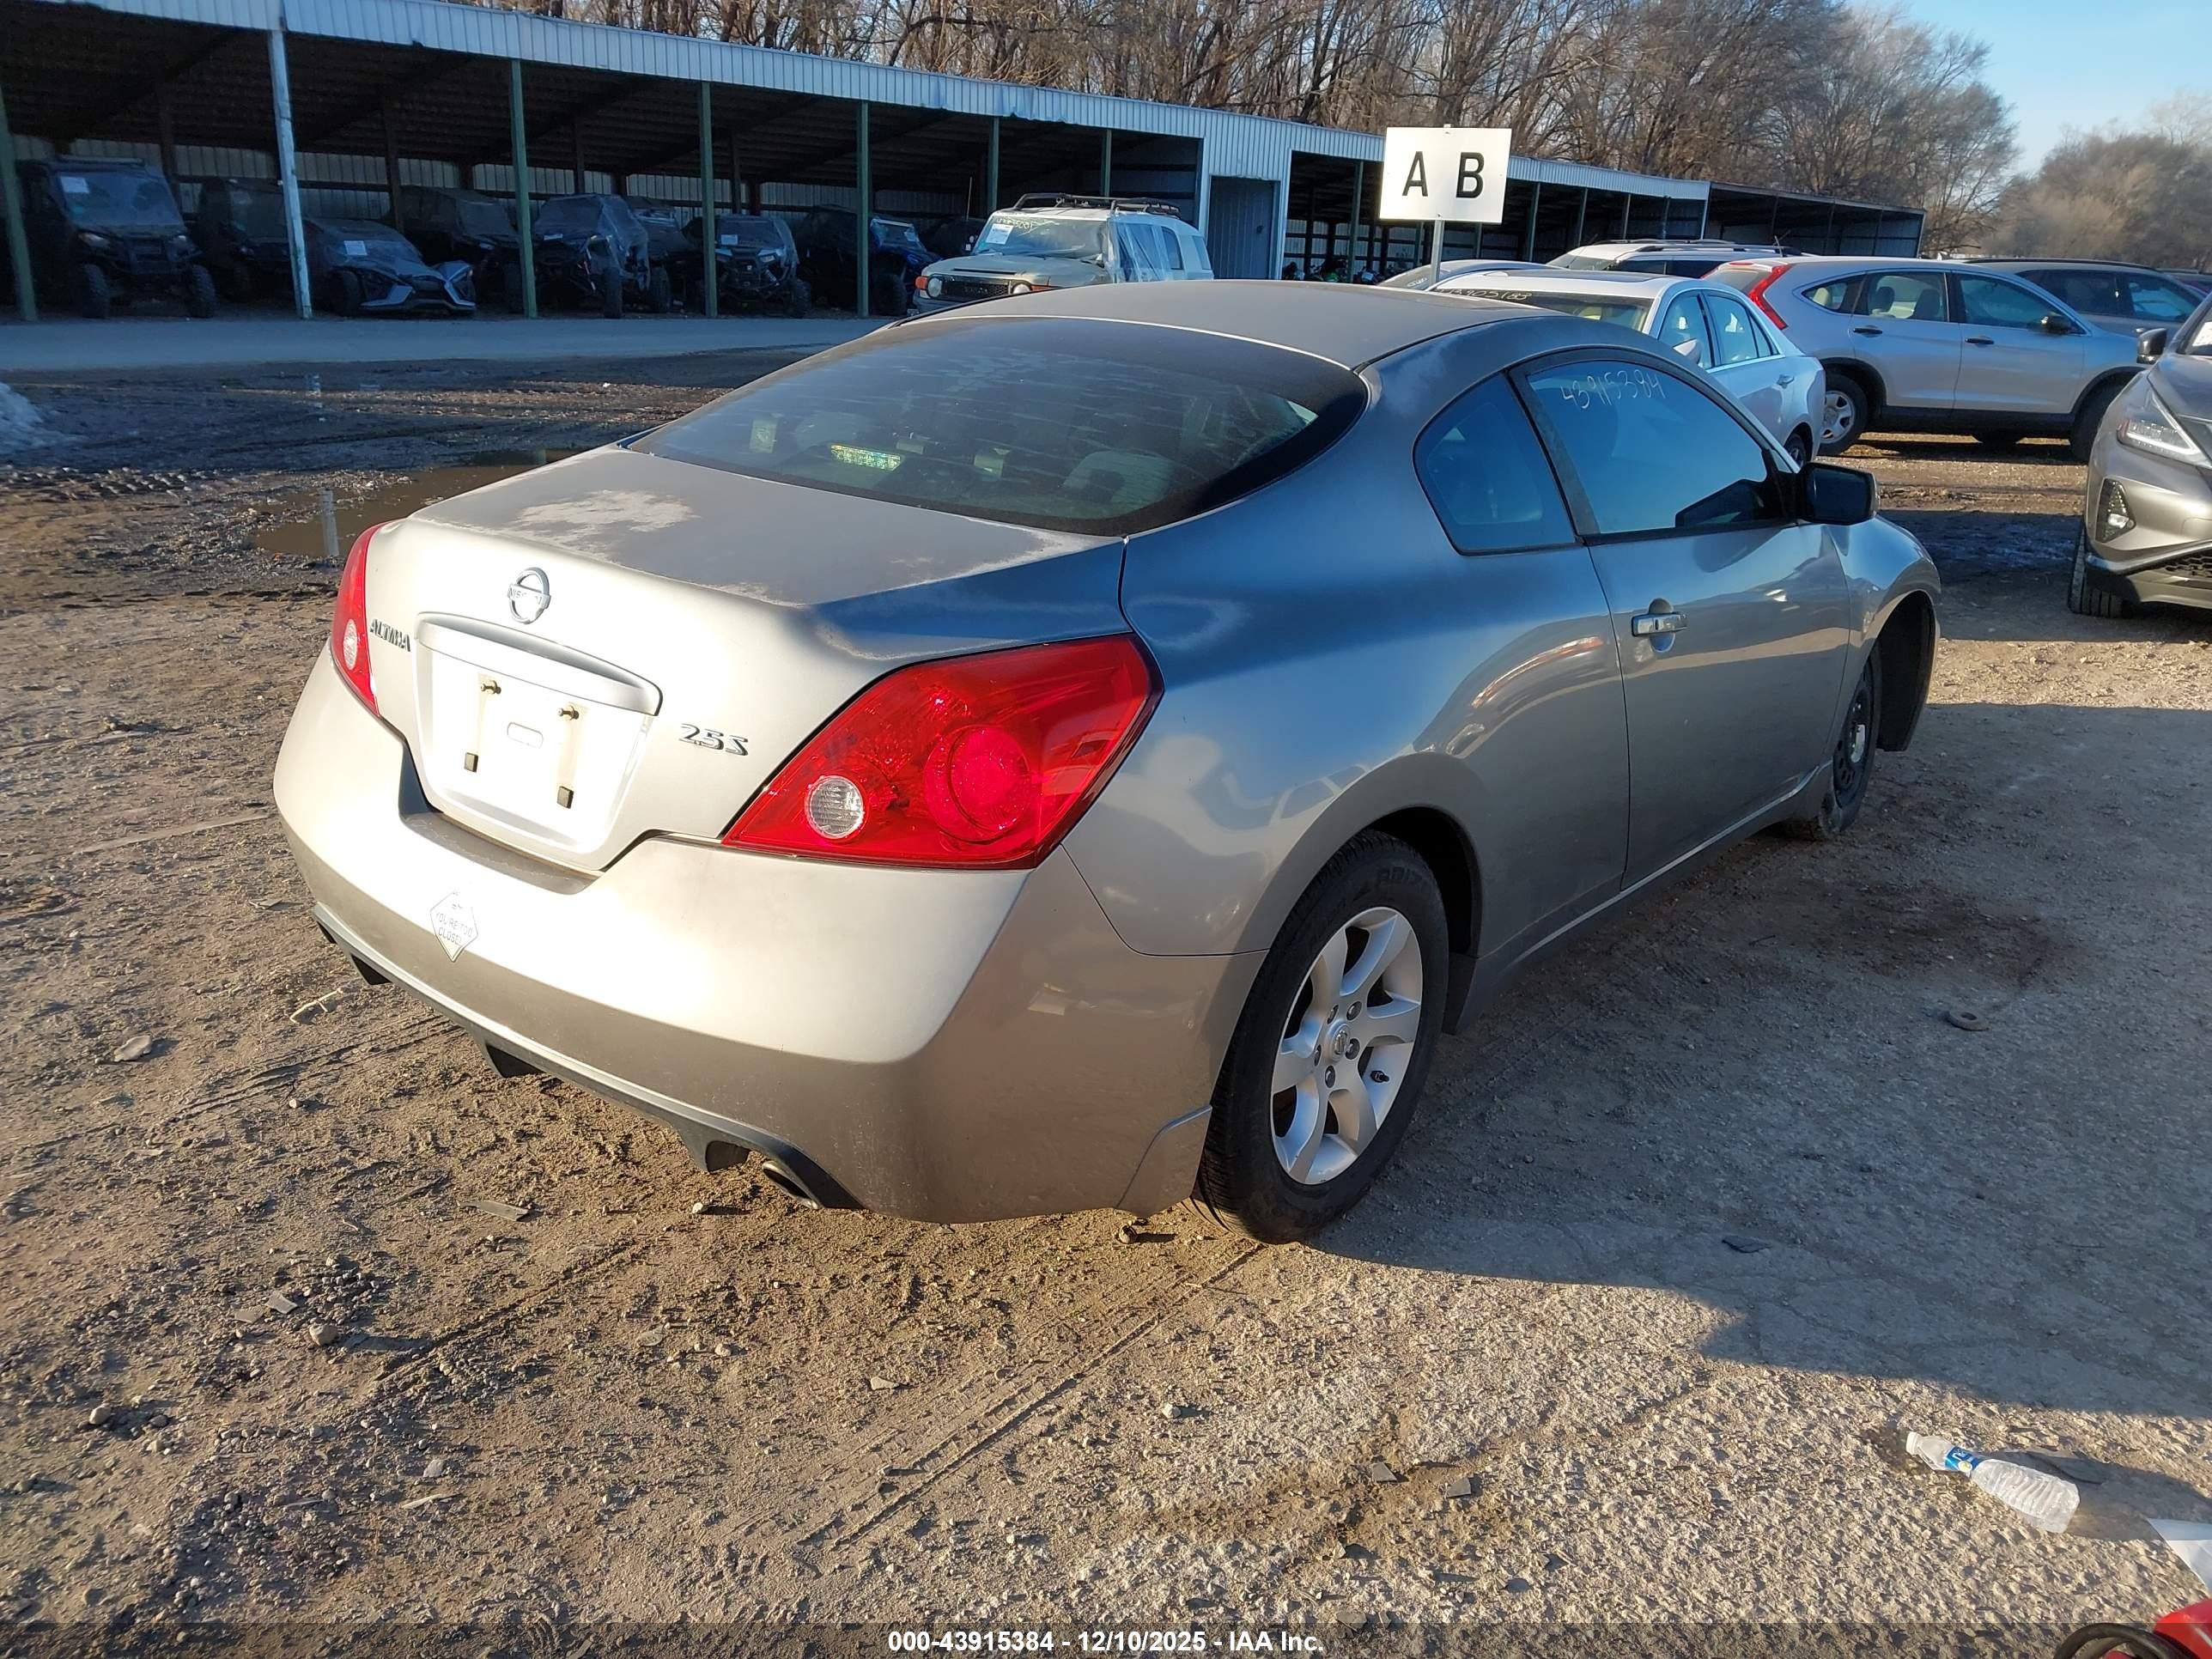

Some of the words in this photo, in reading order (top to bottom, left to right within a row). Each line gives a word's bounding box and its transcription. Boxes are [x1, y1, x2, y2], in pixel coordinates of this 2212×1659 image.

[1402, 151, 1428, 197] A
[1456, 152, 1485, 198] B
[370, 618, 410, 653] ALTIMA
